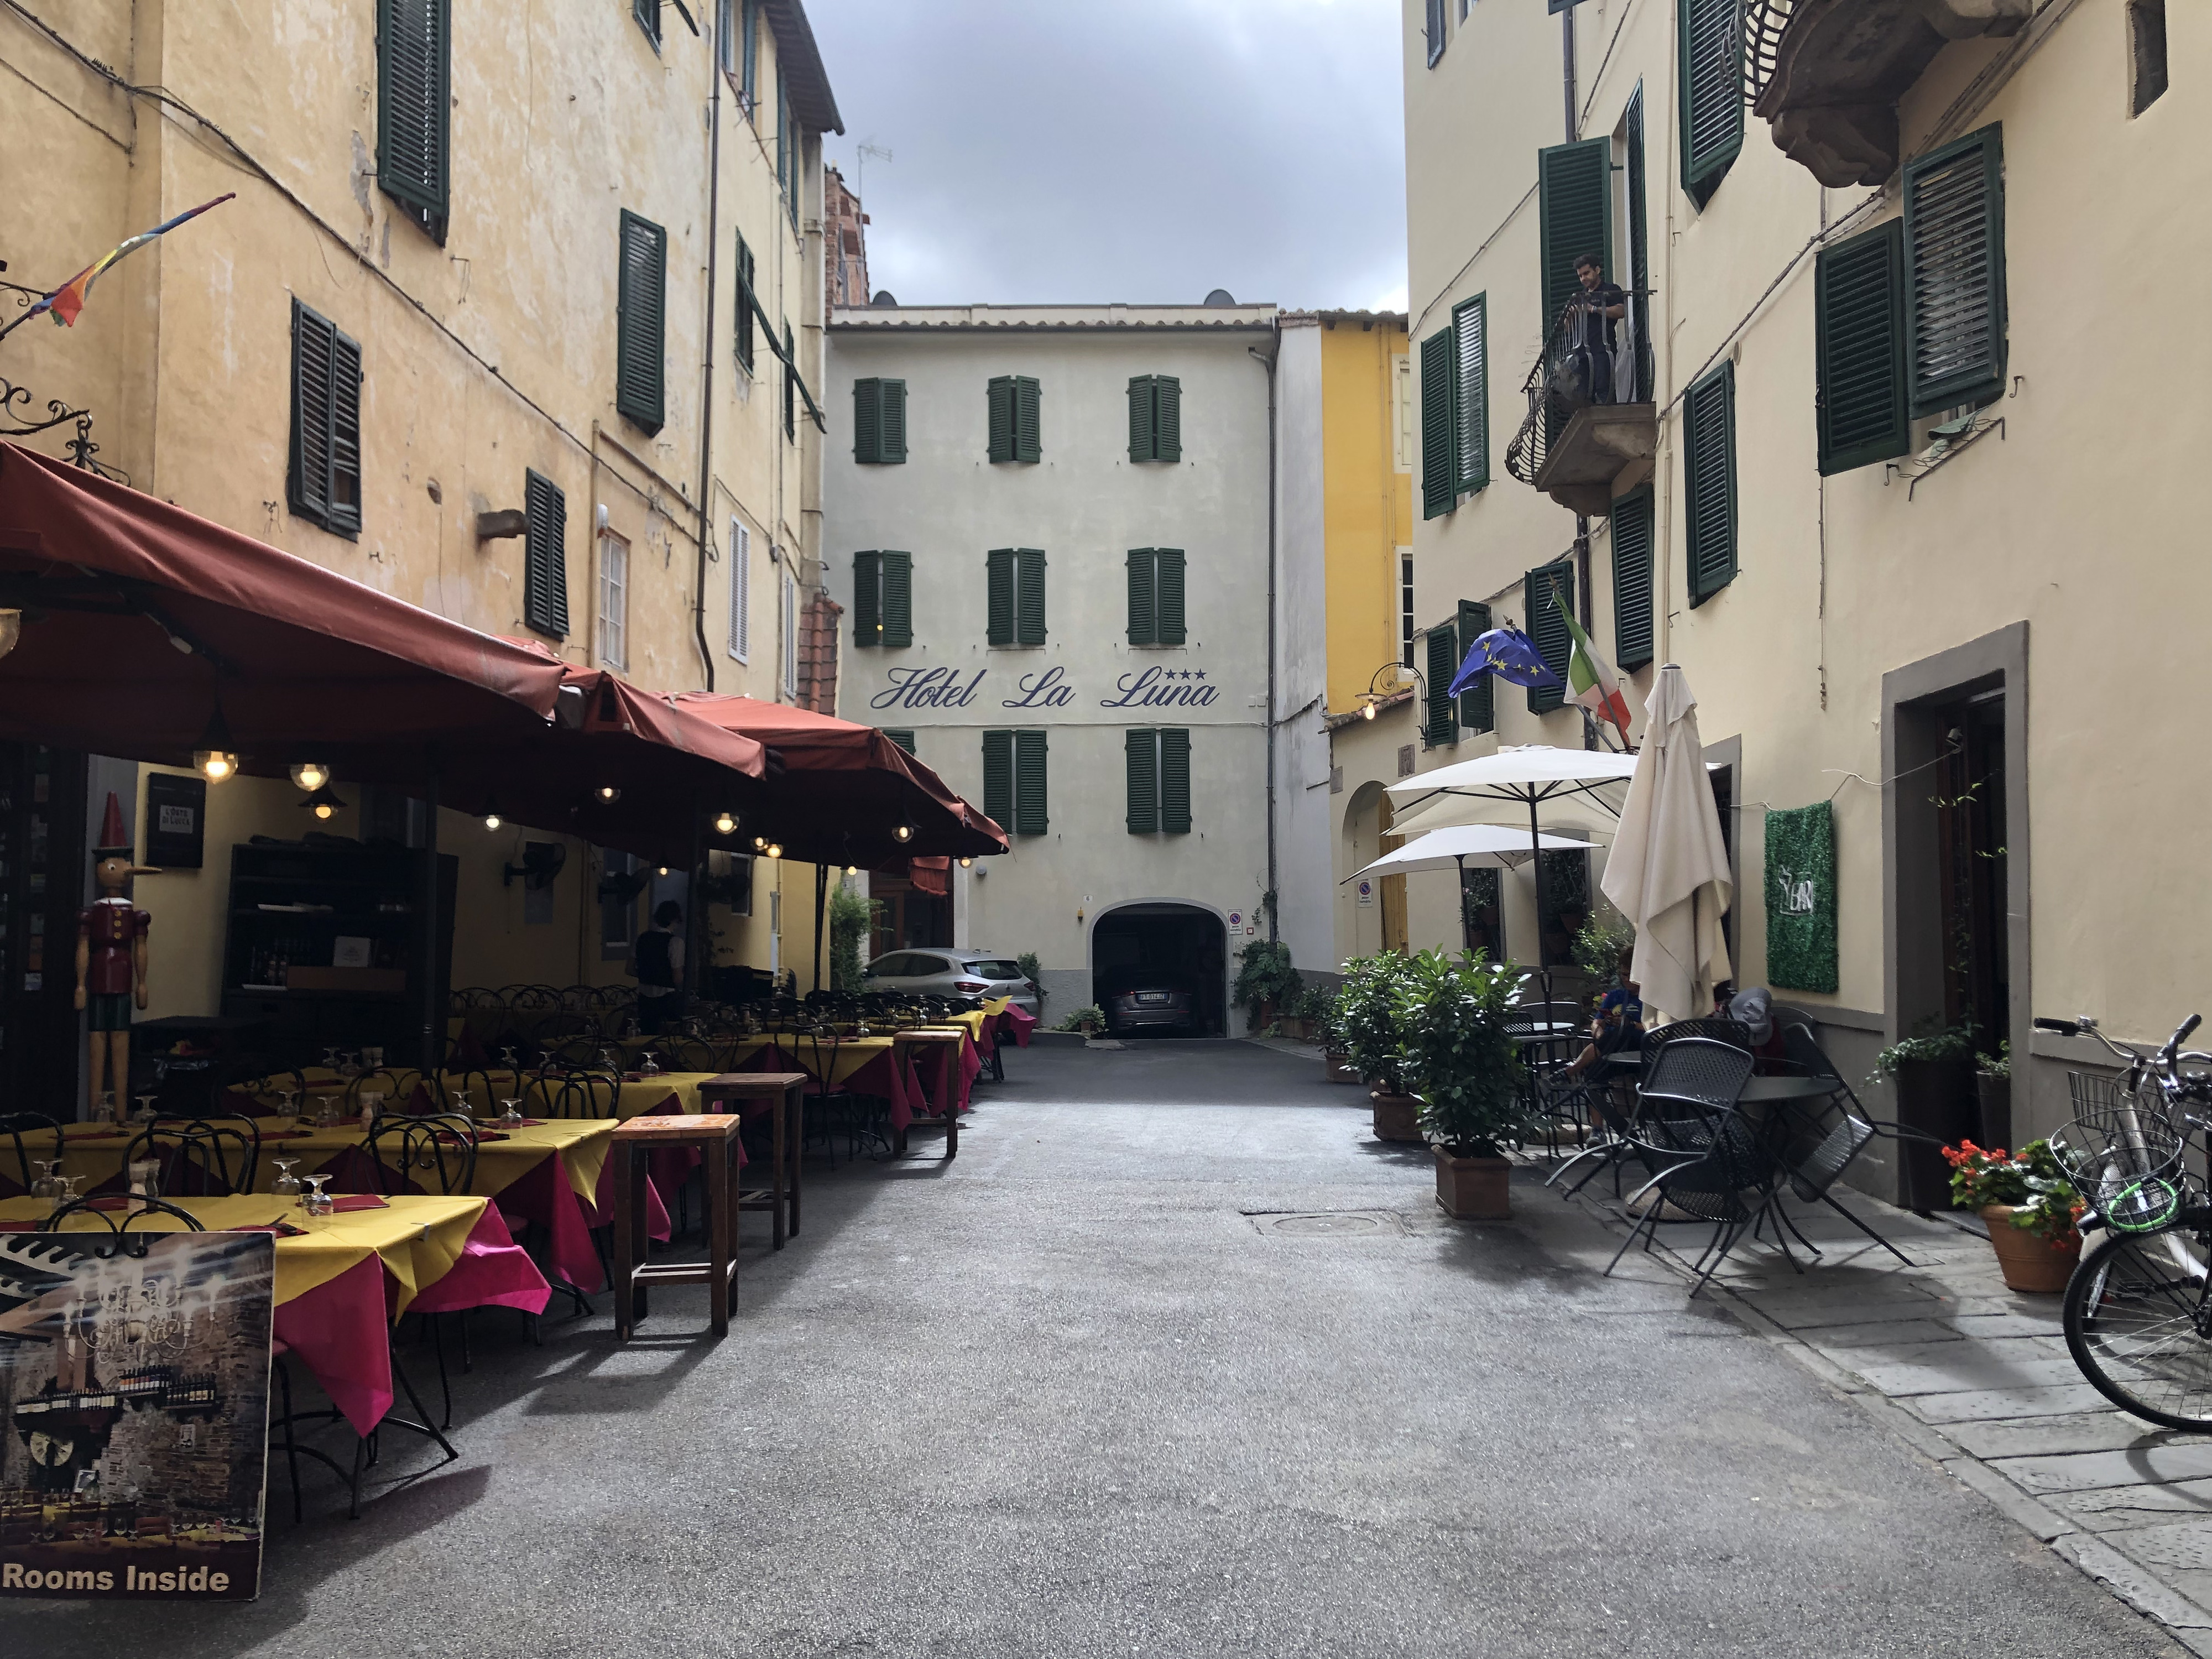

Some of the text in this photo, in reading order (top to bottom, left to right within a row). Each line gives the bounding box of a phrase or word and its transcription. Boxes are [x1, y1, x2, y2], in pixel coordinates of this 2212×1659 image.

[870, 665, 1220, 709] Hotel La Luna
[2, 1563, 230, 1592] Rooms Inside
